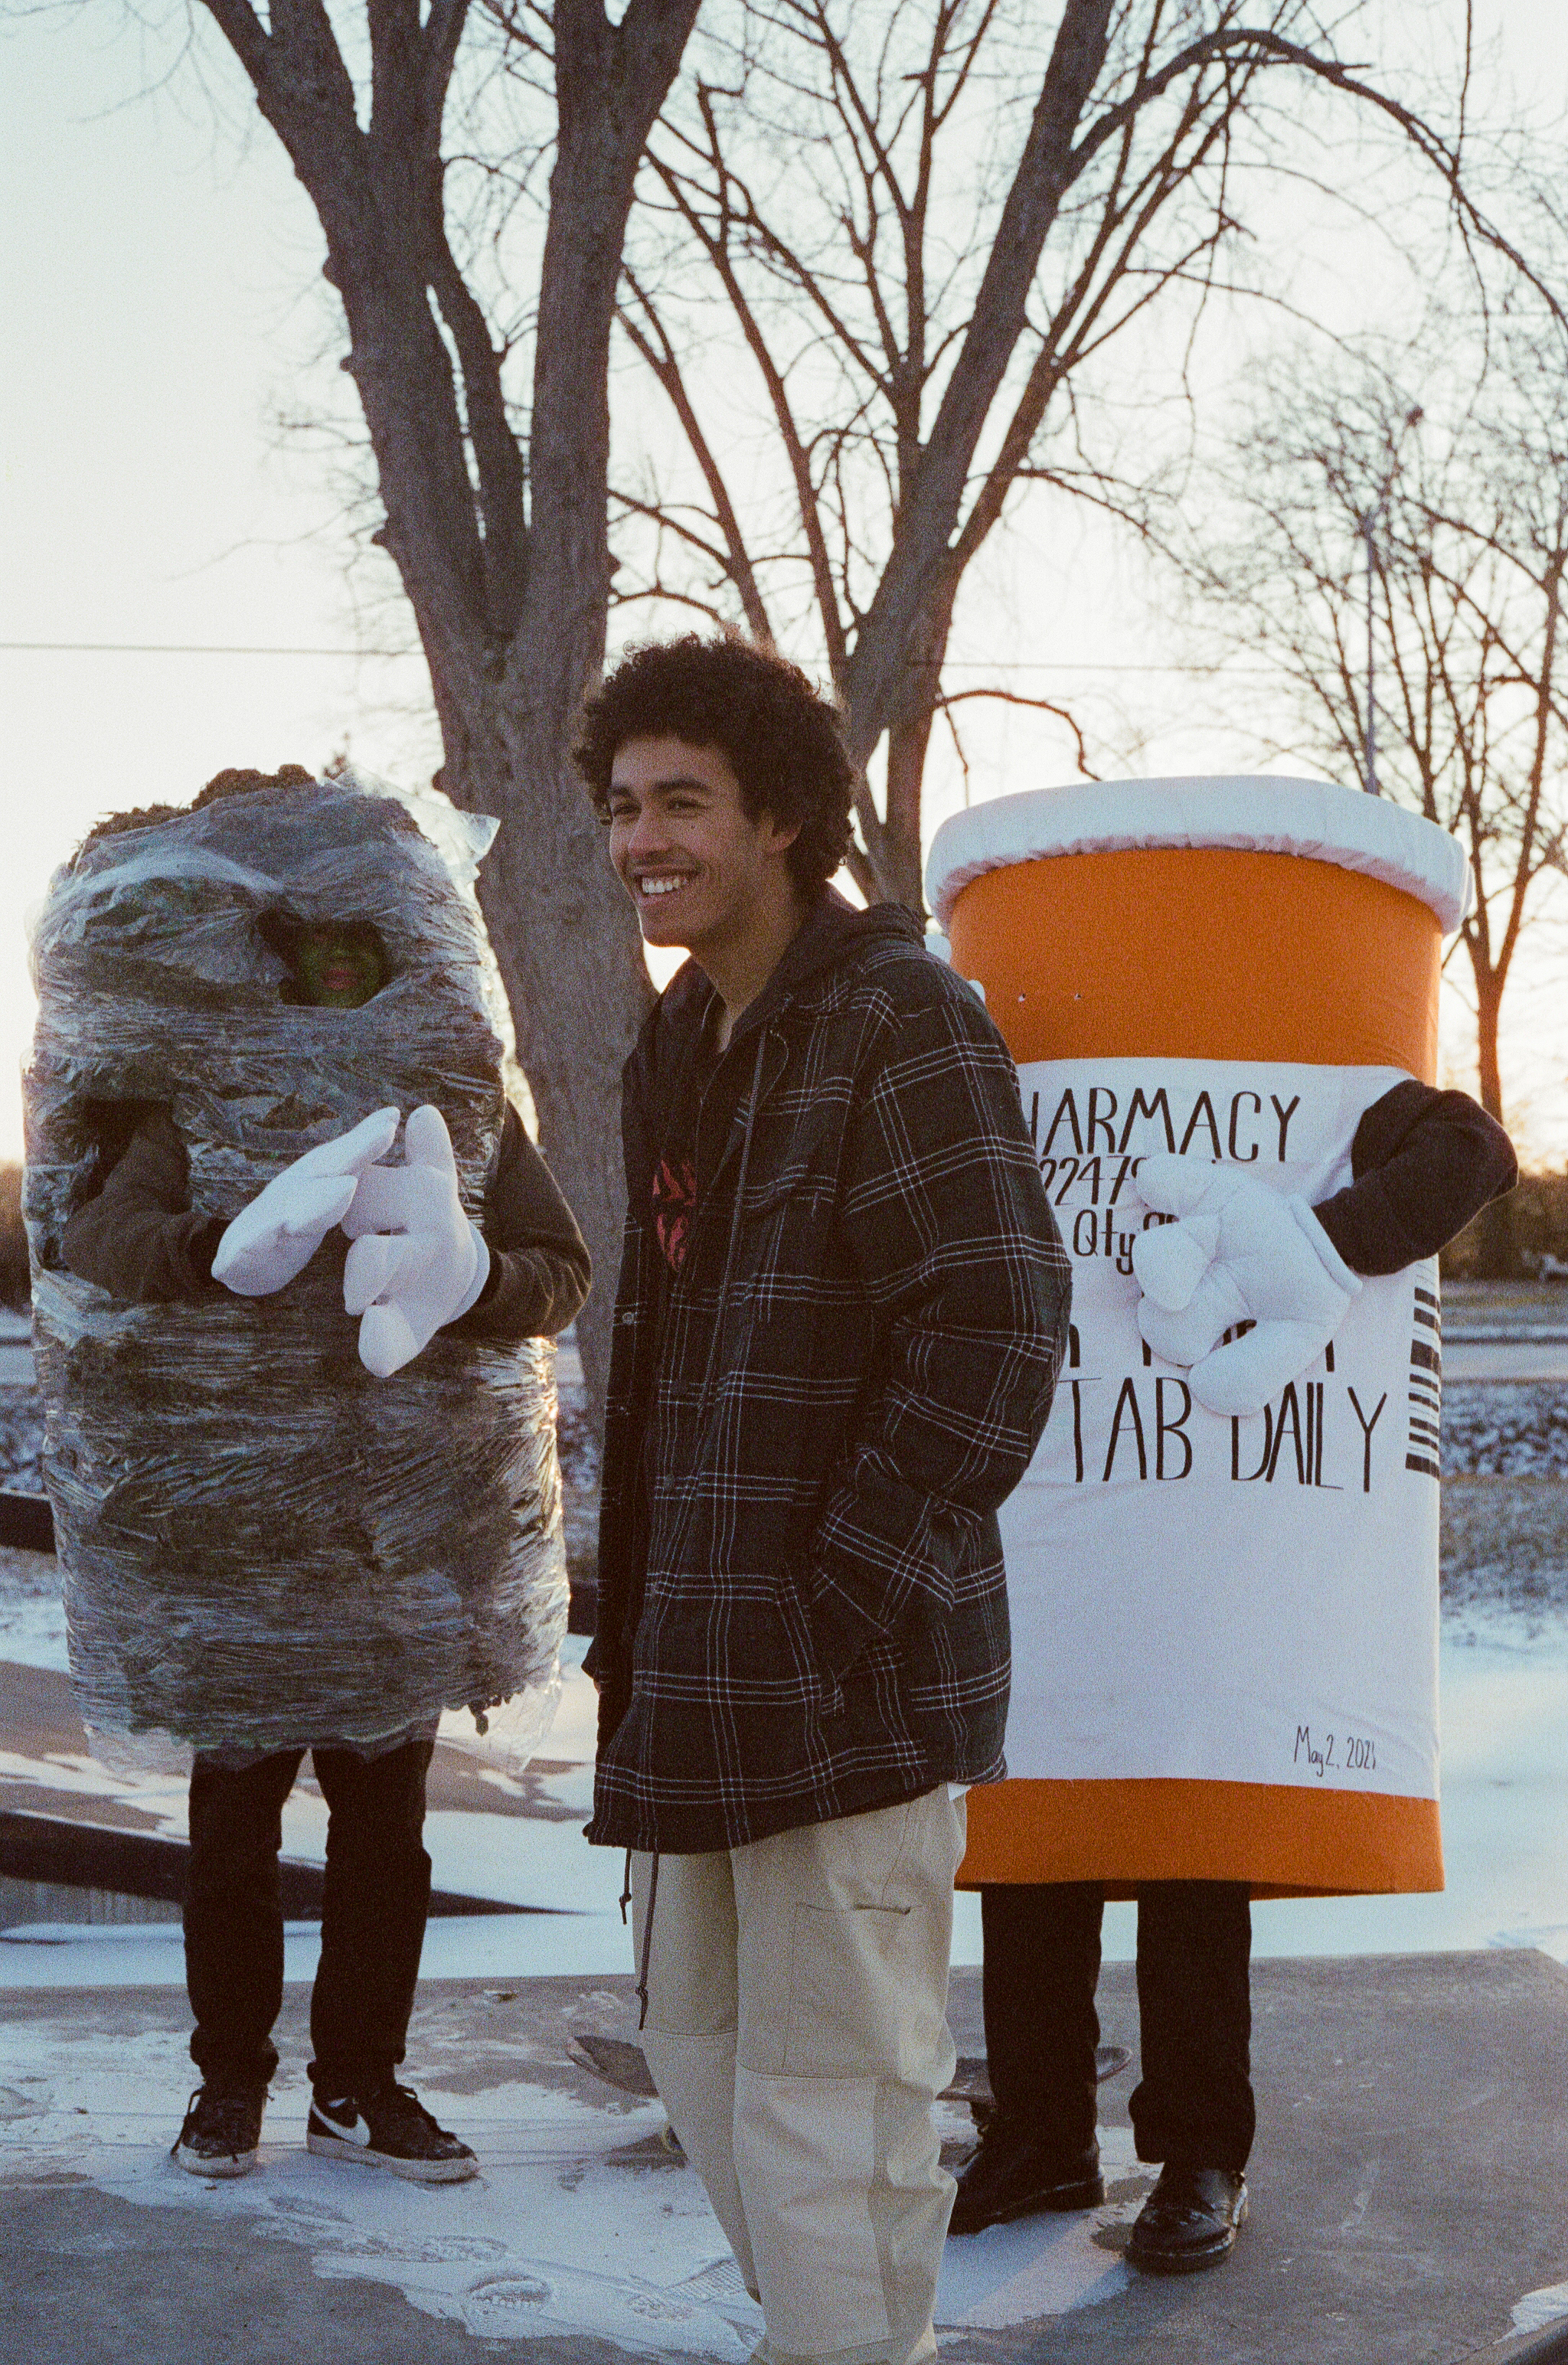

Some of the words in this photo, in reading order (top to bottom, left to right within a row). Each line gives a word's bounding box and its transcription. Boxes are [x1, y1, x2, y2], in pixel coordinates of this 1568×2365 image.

[1025, 1087, 1300, 1162] HARMACY
[1057, 1377, 1193, 1483] TAB
[1231, 1381, 1388, 1494] DAILY
[1294, 1725, 1324, 1777] May
[1346, 1736, 1377, 1770] 2021
